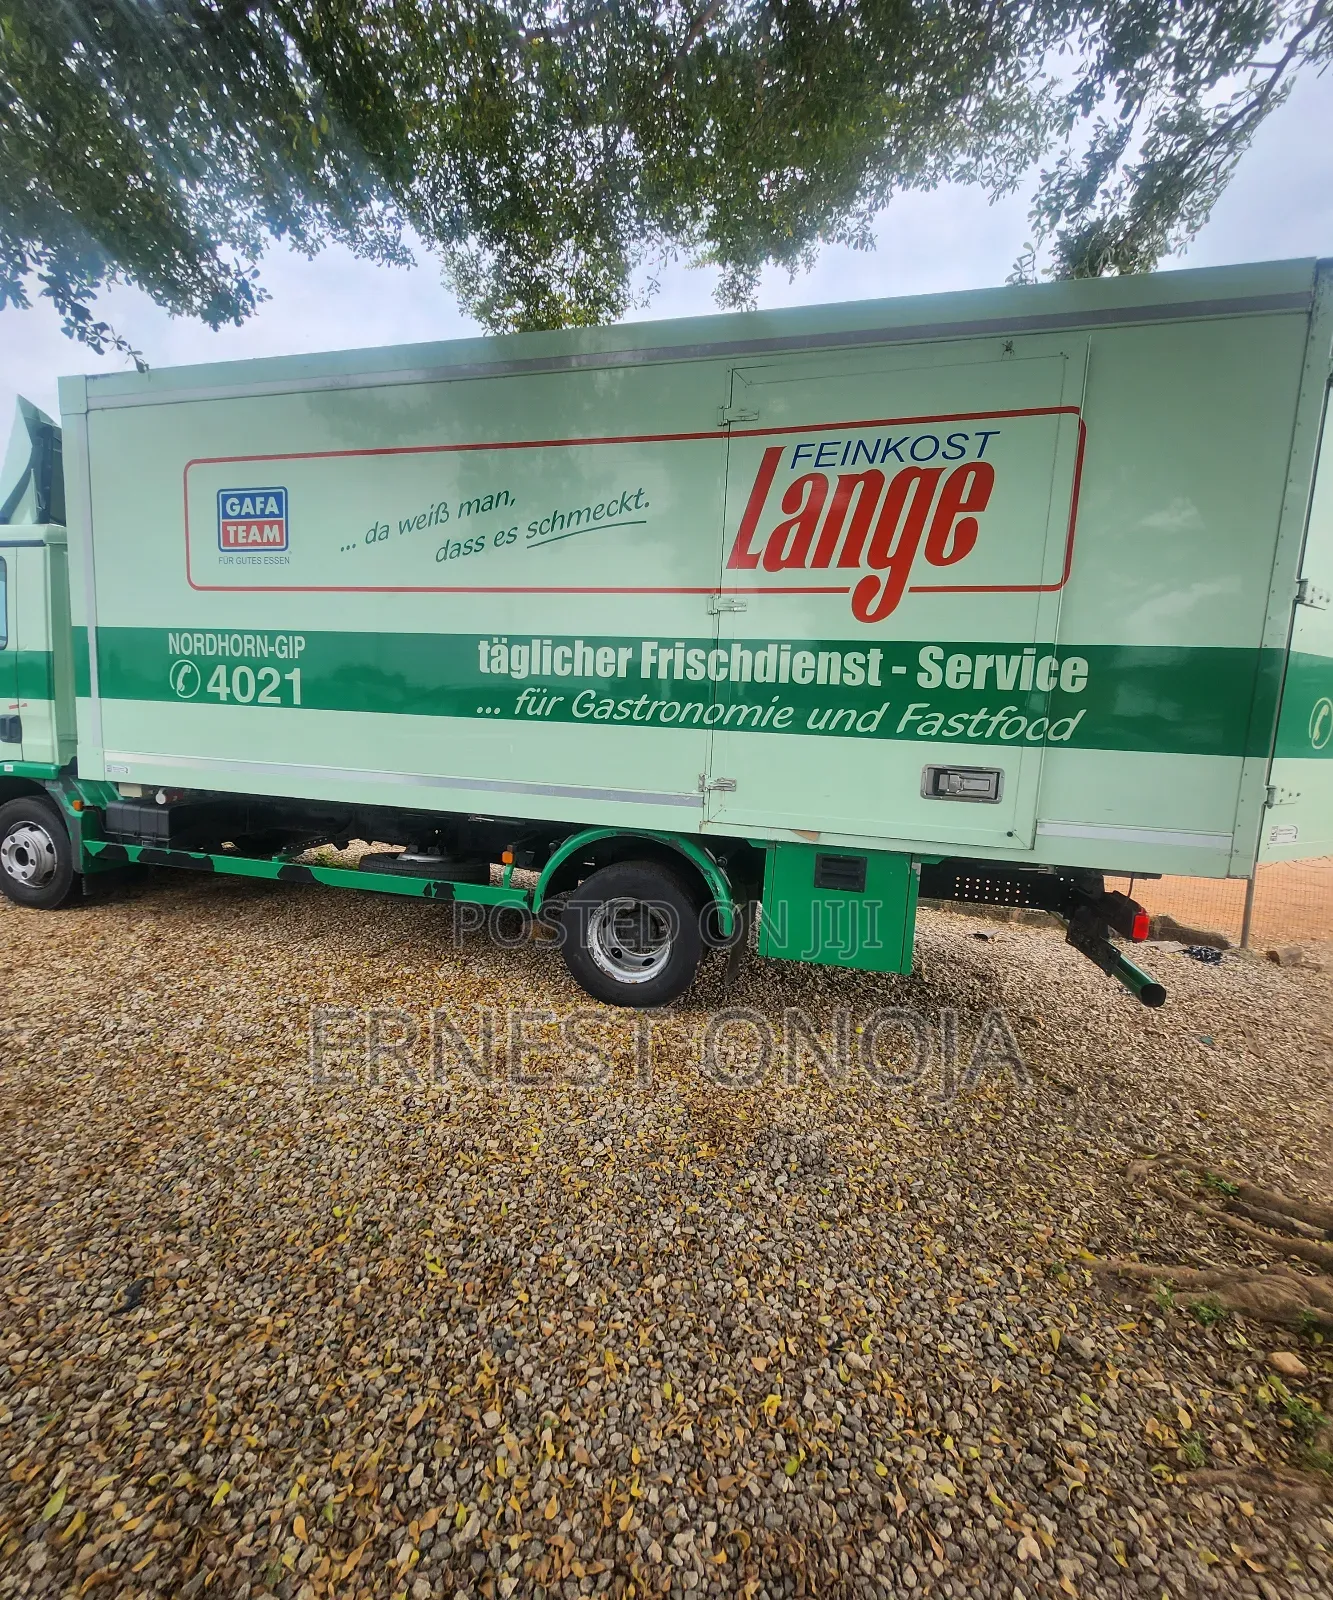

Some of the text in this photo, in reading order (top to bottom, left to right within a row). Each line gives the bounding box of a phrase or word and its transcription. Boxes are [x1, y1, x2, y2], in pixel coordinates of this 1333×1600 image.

[790, 431, 1000, 469] FEINKOST
[225, 496, 280, 516] GAFA
[365, 521, 389, 545] da
[399, 503, 449, 535] weiß
[457, 489, 515, 519] man,
[435, 487, 650, 563] dass es schmeckt.
[226, 524, 281, 543] TEAM
[726, 445, 995, 623] Lange
[218, 555, 290, 565] FÜR GUTES ESSEN
[168, 632, 306, 659] NORDHORN-GIP
[478, 637, 632, 679] täglicher
[640, 641, 883, 687] Frischdienst
[917, 645, 1089, 693] Service
[206, 664, 302, 705] 4021
[514, 687, 564, 716] für
[571, 689, 795, 729] Gastronomie
[806, 701, 890, 733] und
[896, 701, 1087, 741] Fastfood
